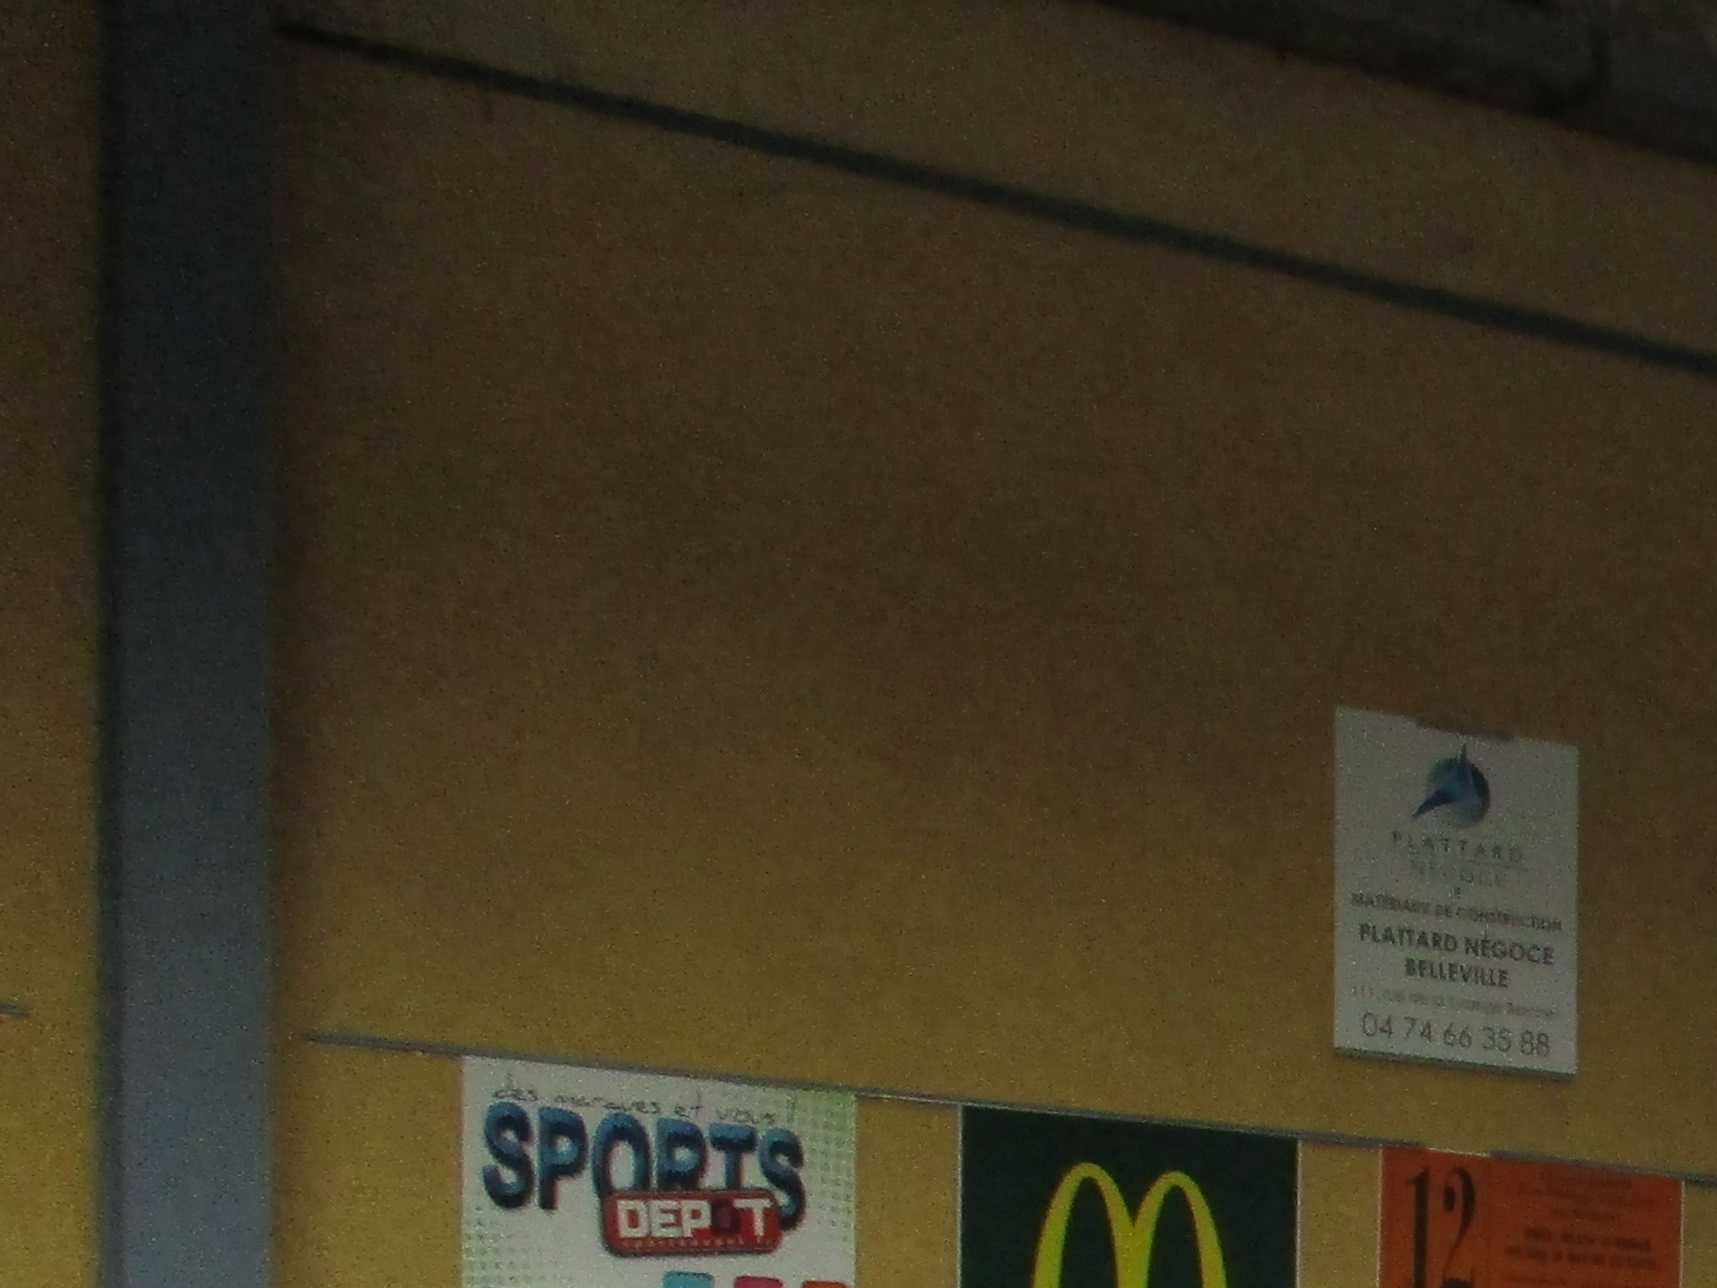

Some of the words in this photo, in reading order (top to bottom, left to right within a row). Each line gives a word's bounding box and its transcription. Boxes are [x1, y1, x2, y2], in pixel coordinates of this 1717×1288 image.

[1358, 922, 1458, 952] PLATTARD
[1404, 956, 1510, 989] BELLEVILLE
[1361, 1011, 1394, 1038] 04
[1404, 1016, 1433, 1043] 74
[482, 1101, 806, 1232] SPORTS
